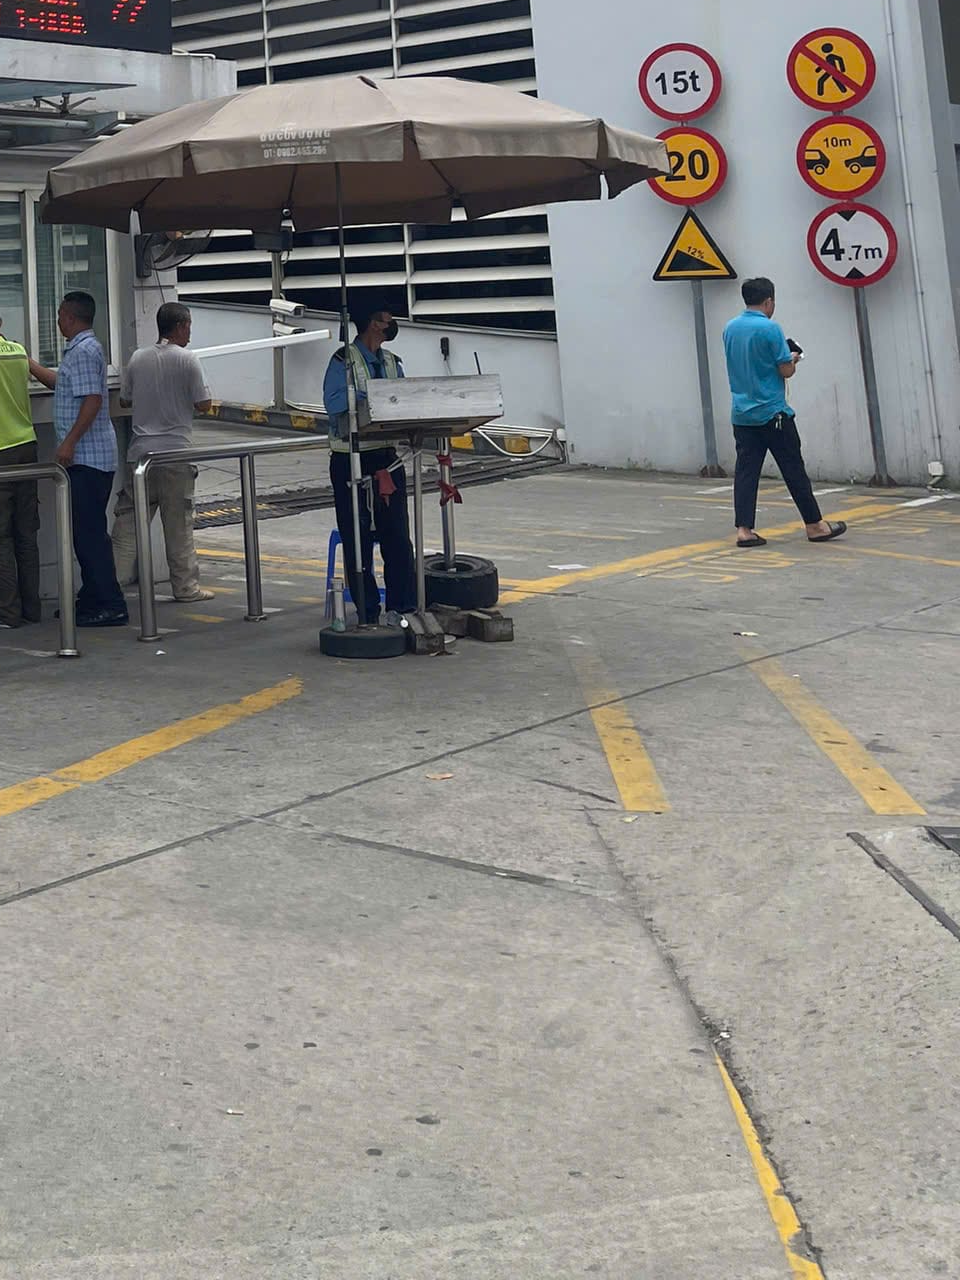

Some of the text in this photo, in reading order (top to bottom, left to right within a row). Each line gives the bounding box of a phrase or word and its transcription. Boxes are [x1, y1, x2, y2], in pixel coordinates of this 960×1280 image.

[654, 70, 701, 96] 15t
[823, 136, 852, 149] 10m
[664, 149, 710, 182] 20
[686, 246, 705, 260] 12%
[820, 228, 883, 261] 4.7m
